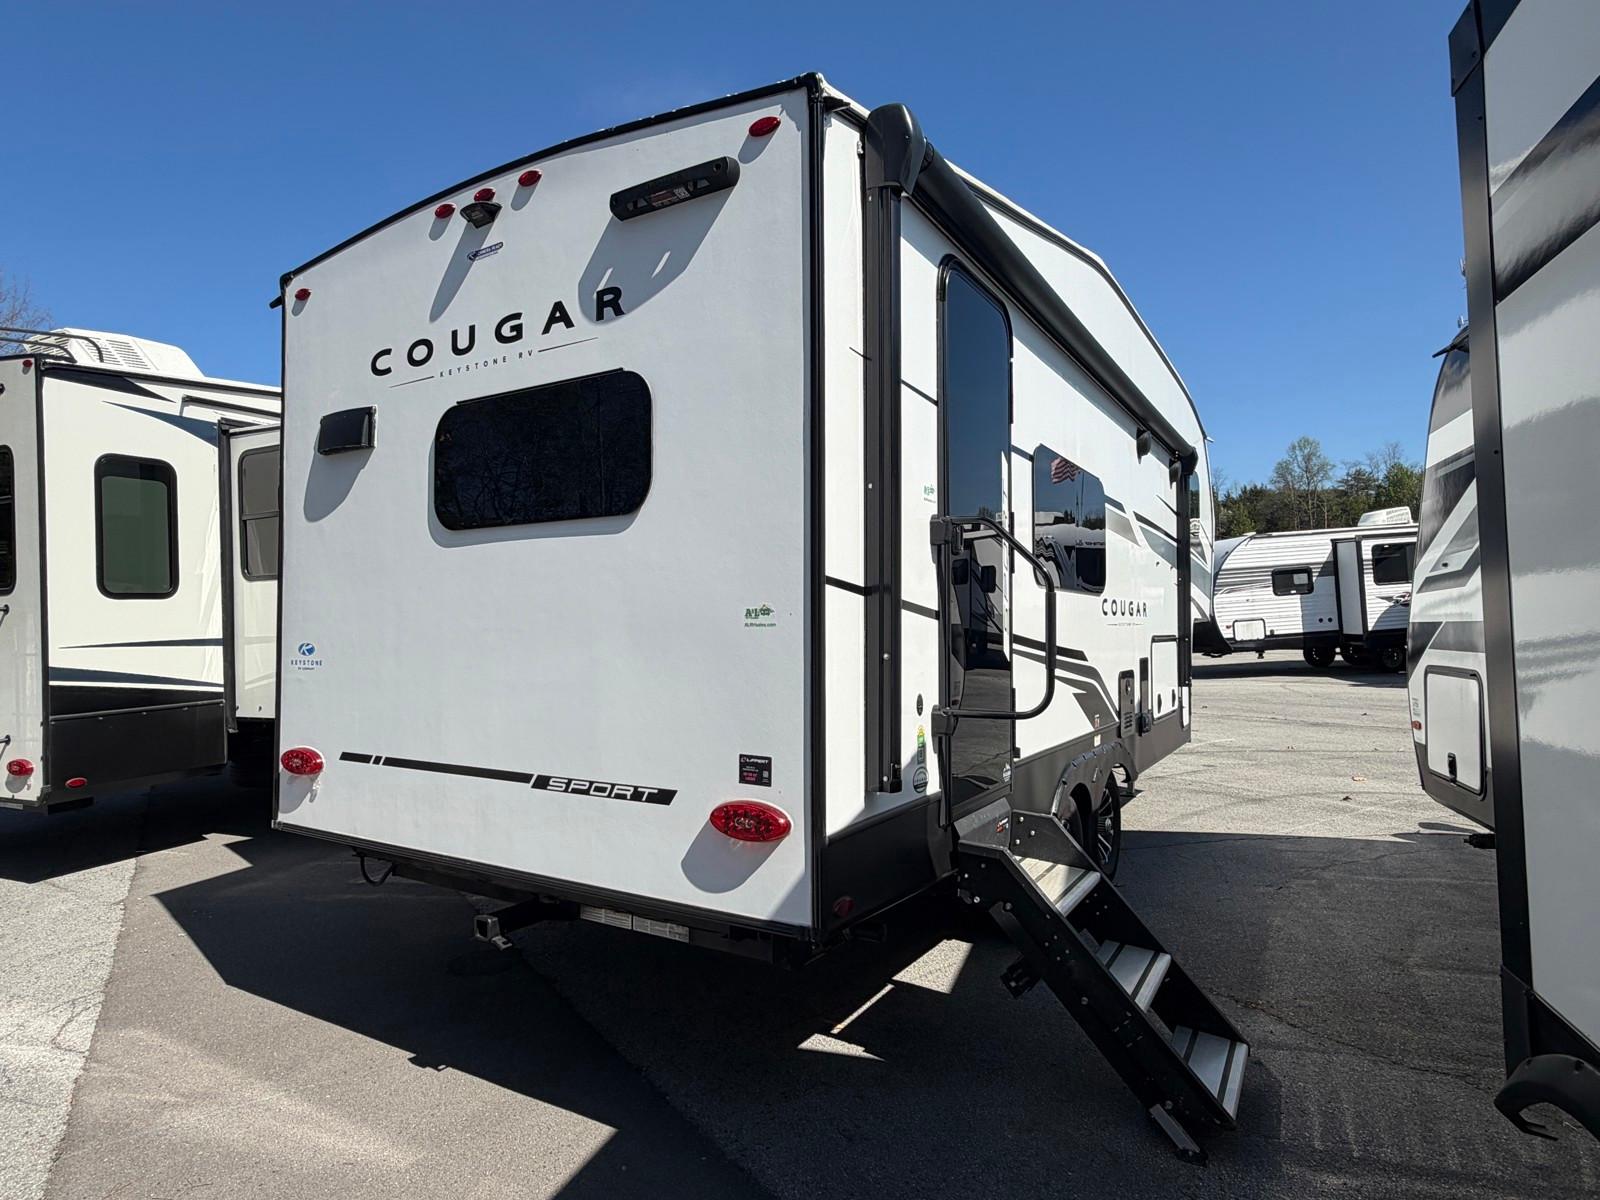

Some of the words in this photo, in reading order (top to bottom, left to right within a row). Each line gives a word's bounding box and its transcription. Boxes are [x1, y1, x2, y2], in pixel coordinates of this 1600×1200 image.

[370, 286, 626, 377] COUGAR
[439, 355, 508, 378] KEYSTONE
[517, 349, 535, 360] RV
[1101, 598, 1147, 618] COUGAR
[546, 777, 659, 802] SPORT
